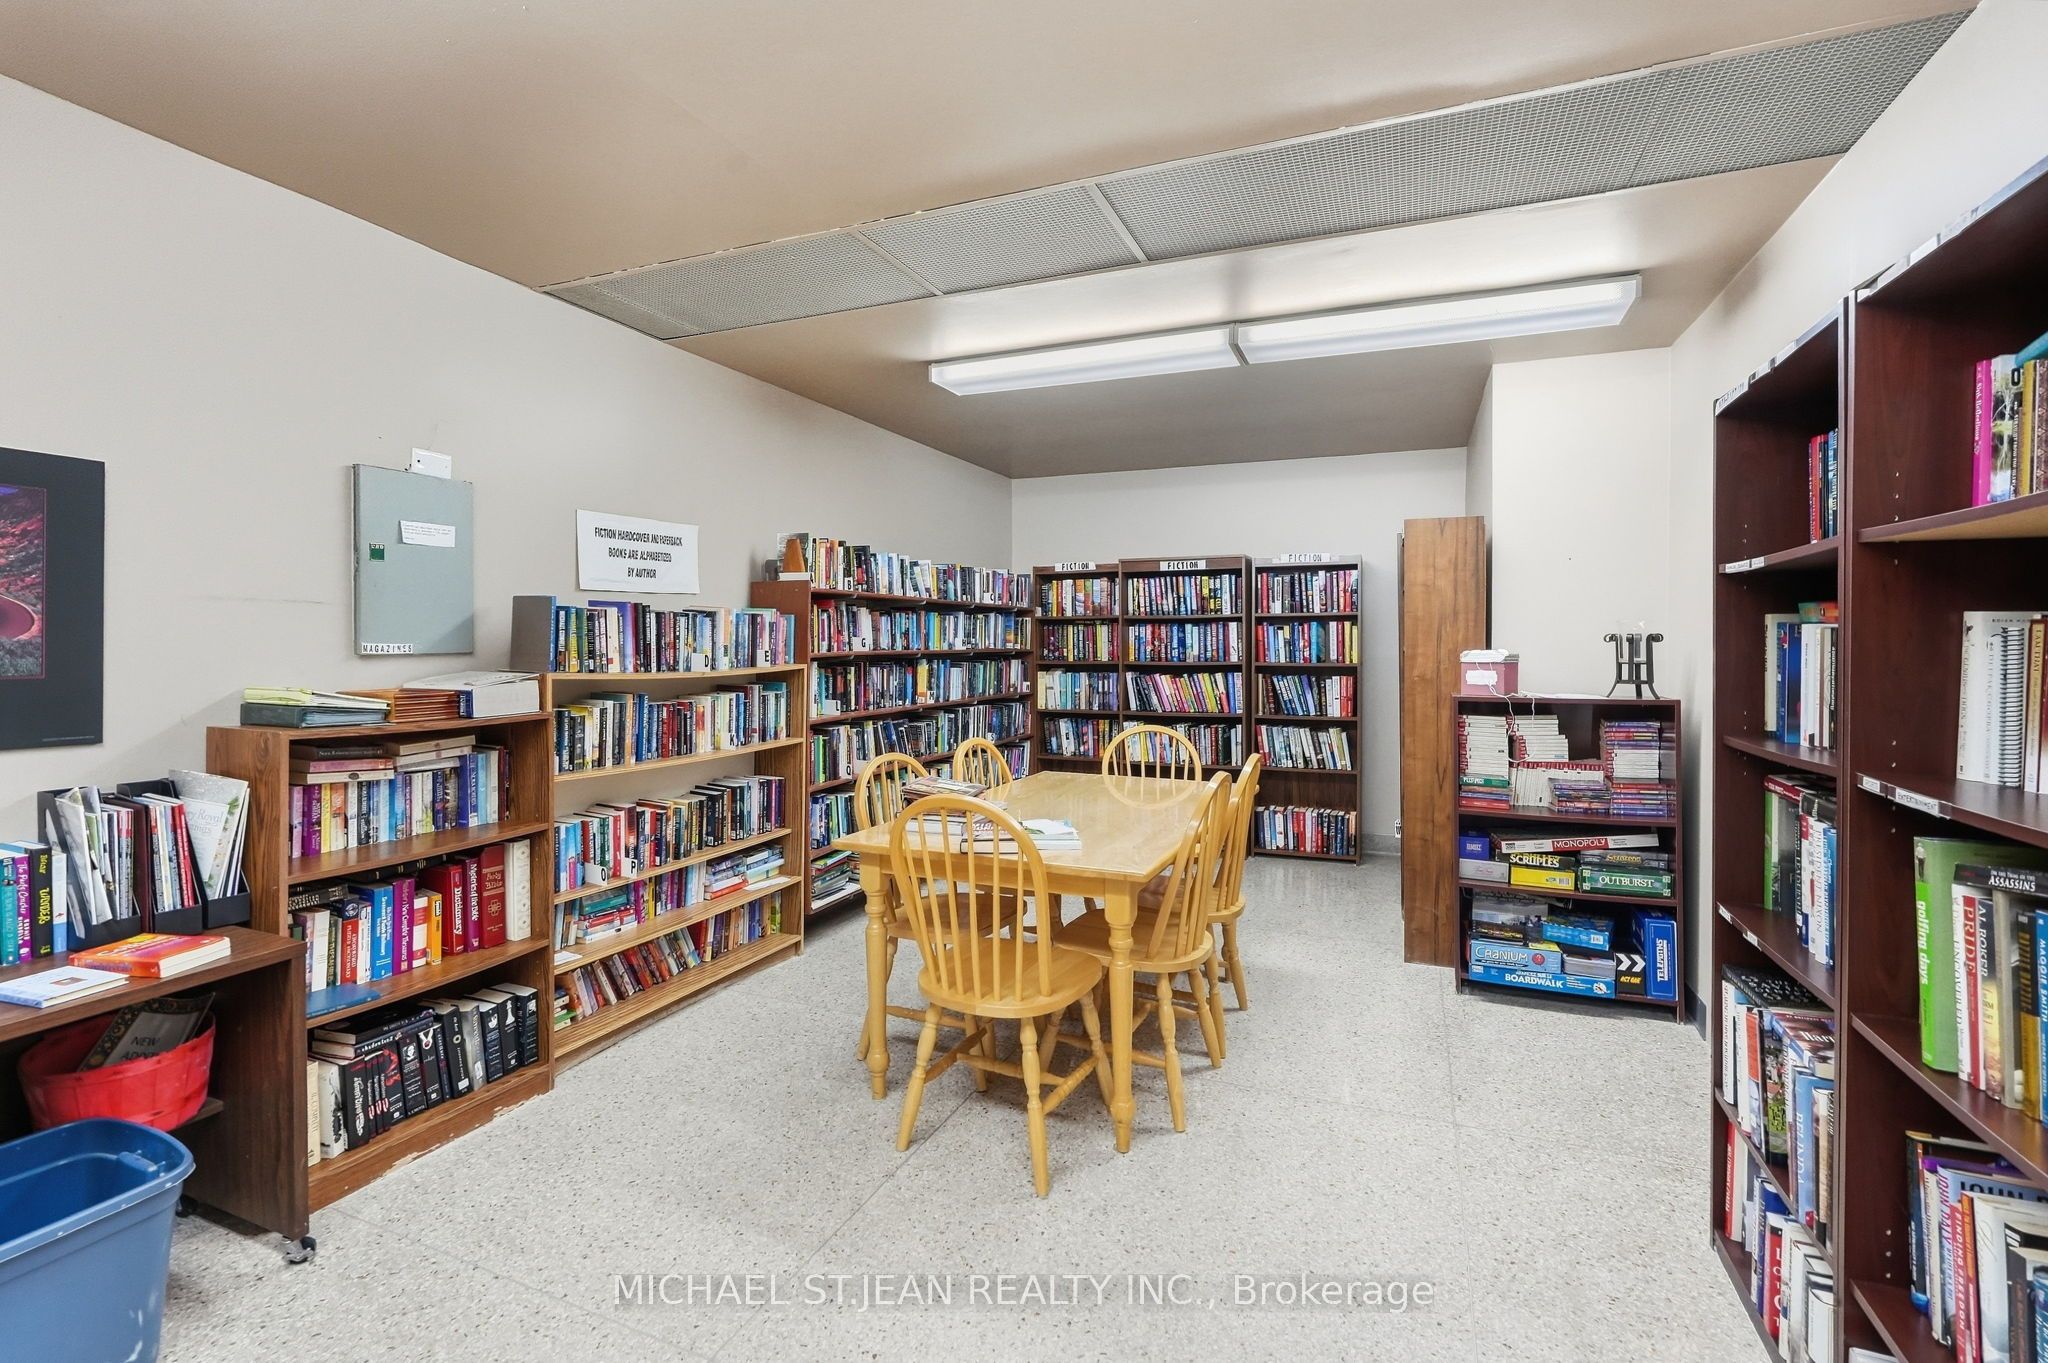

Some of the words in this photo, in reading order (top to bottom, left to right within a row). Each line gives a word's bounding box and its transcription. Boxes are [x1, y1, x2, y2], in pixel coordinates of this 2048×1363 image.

[594, 526, 616, 539] FICTION
[618, 530, 650, 543] HARDCOVER
[608, 547, 628, 560] BOOKS
[628, 548, 639, 561] ARE
[640, 550, 672, 563] ALPHABETIZED
[1288, 554, 1322, 562] FICTION
[1062, 562, 1090, 570] FICTION
[1167, 561, 1199, 570] FICTION
[628, 567, 635, 578] BY
[635, 567, 657, 579] AUTHOR
[848, 580, 852, 589] B
[990, 593, 994, 601] C
[362, 644, 412, 653] MAGAZINES
[862, 638, 866, 647] G
[704, 655, 709, 667] D
[765, 651, 770, 662] E
[836, 701, 839, 712] L
[730, 734, 735, 746] K
[846, 766, 851, 775] Q
[1554, 838, 1605, 848] MONOPOLY
[631, 861, 636, 873] P
[1510, 853, 1560, 867] SCRUPLES
[1600, 876, 1654, 887] OUTBURST
[1988, 876, 2036, 891] ASSASSINS
[37, 888, 50, 925] WONDER
[454, 887, 464, 935] Dictionary
[1978, 904, 1986, 921] AL
[1917, 900, 1929, 948] golfing
[1964, 906, 1976, 973] PRIDE
[1980, 928, 1988, 976] ROKER
[1920, 953, 1930, 984] days
[2040, 939, 2048, 988] MAGGIE
[1505, 974, 1564, 988] BOARDWALK
[2040, 990, 2048, 1022] SMITH
[1936, 1175, 1950, 1208] JOHN
[1940, 1210, 1952, 1246] DALY
[1956, 1212, 1964, 1264] FINDING
[1958, 1268, 1966, 1330] FREEDOM
